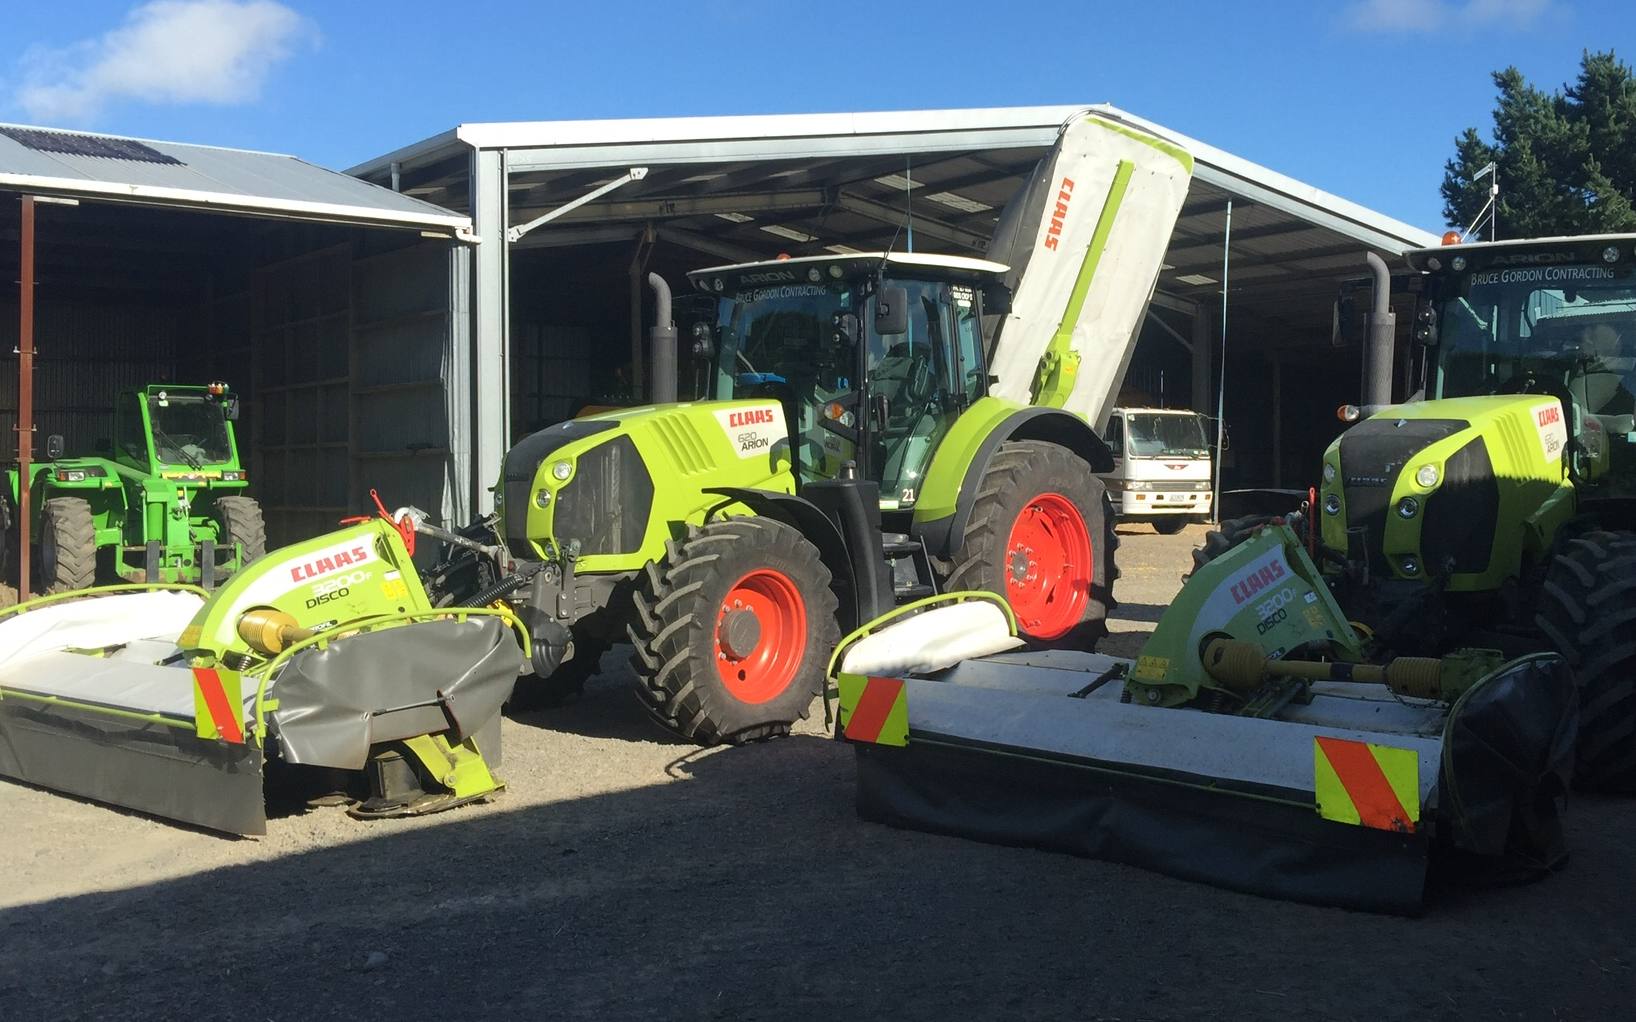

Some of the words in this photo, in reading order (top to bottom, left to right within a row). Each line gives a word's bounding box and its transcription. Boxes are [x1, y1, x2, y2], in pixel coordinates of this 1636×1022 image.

[1044, 177, 1075, 252] CLAAS
[1491, 252, 1575, 265] ARION
[740, 270, 795, 284] ARION
[1471, 273, 1498, 286] BRUCE
[1501, 269, 1543, 283] GORDON
[1545, 267, 1614, 280] CONTRACTING
[753, 289, 780, 301] GORDON
[780, 285, 826, 298] CONTRACTING
[729, 409, 774, 428] CLAAS
[1538, 407, 1560, 427] CLAAS
[738, 431, 757, 443] 620
[741, 437, 769, 451] ARION
[902, 488, 916, 502] 21
[291, 546, 368, 583] CLAAS
[1230, 559, 1286, 605] CLAAS
[305, 587, 350, 609] DISCO
[1256, 608, 1288, 636] DISCO
